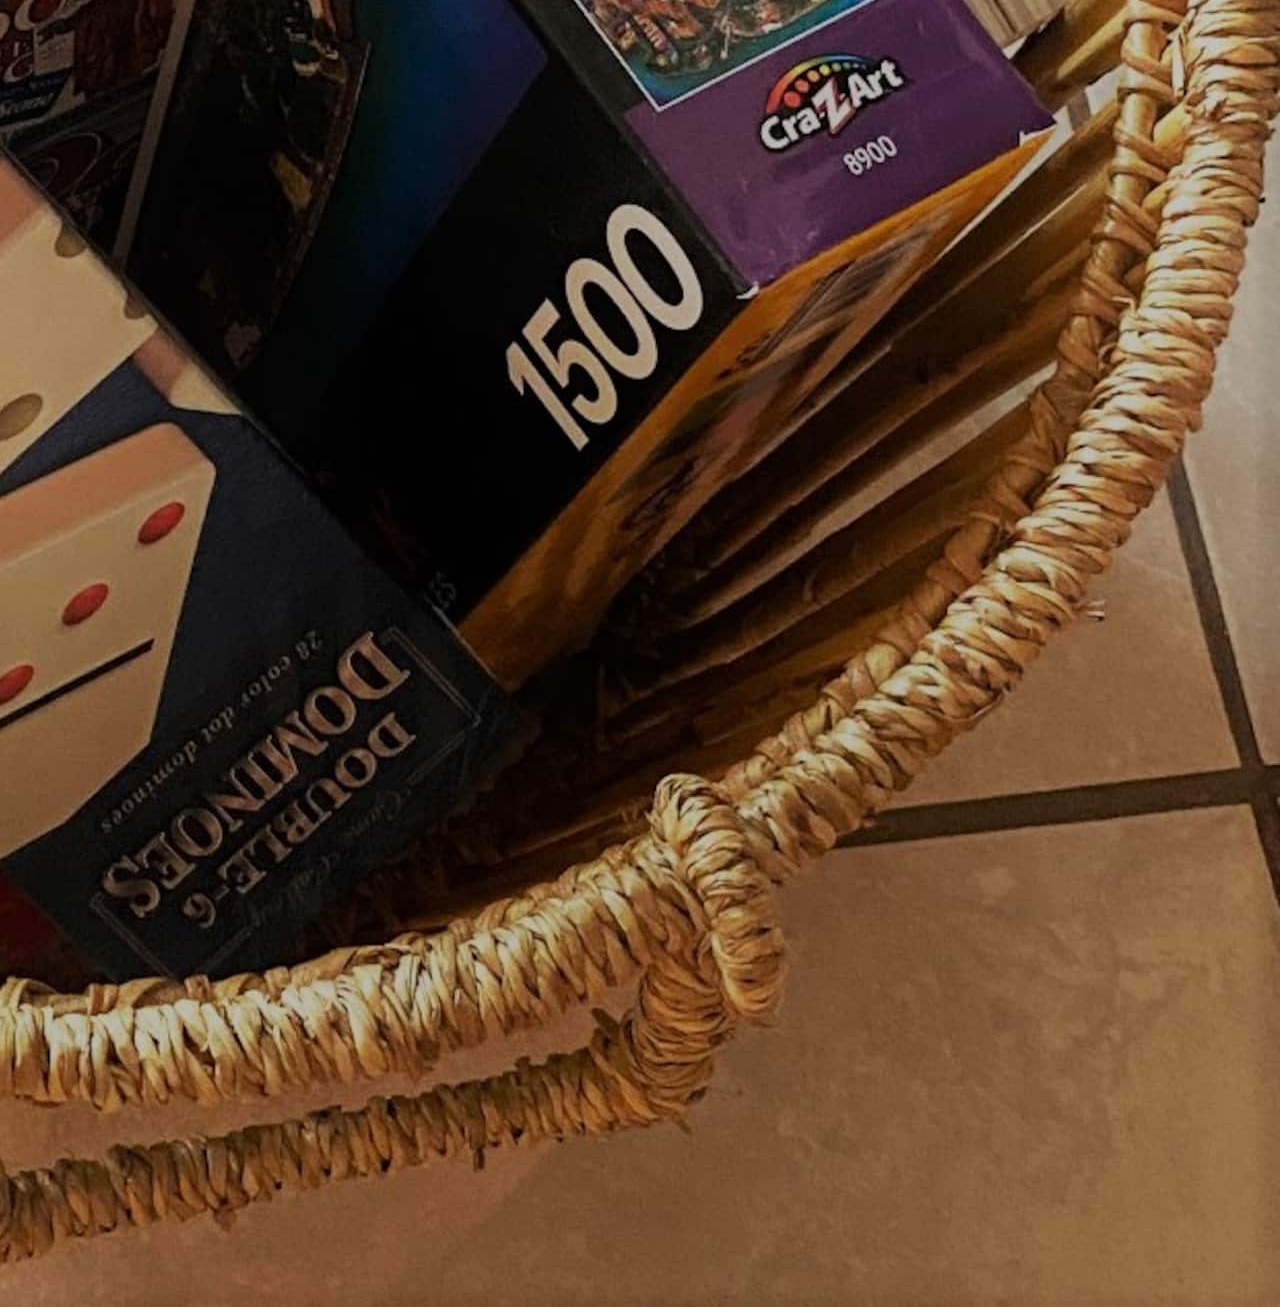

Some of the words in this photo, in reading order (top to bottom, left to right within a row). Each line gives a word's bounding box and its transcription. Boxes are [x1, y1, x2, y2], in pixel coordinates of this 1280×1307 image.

[843, 135, 898, 176] 8900
[505, 204, 704, 452] 1500
[294, 628, 324, 662] 28
[240, 658, 293, 705] color
[200, 707, 234, 742] dot
[101, 631, 412, 919] DOMINOES
[101, 740, 197, 835] dominoes
